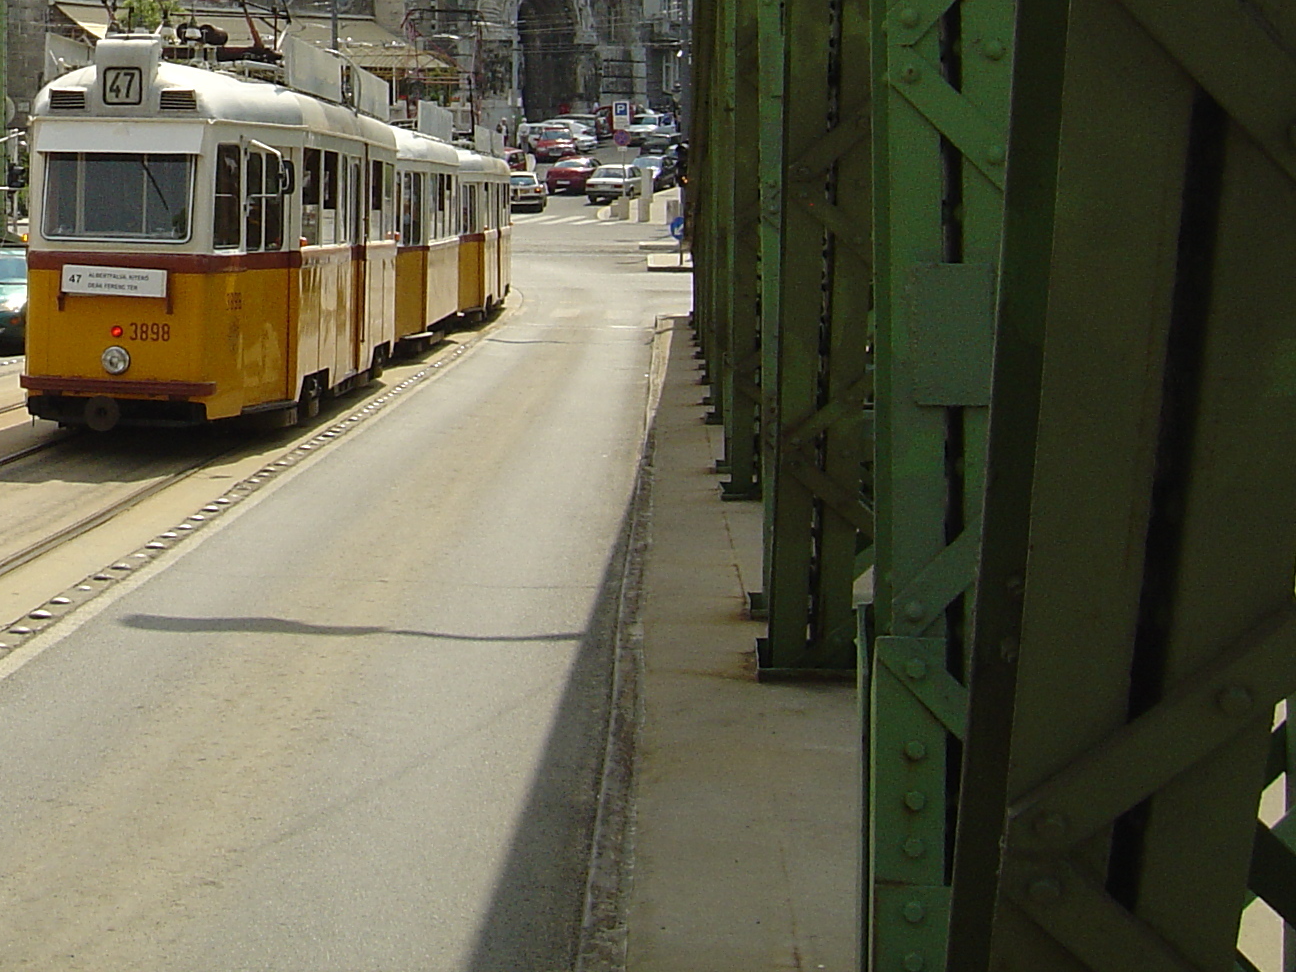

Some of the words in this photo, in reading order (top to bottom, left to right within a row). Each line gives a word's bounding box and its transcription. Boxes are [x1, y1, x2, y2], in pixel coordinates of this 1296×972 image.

[109, 71, 135, 98] 47
[68, 274, 82, 284] 47
[129, 322, 171, 342] 3898
